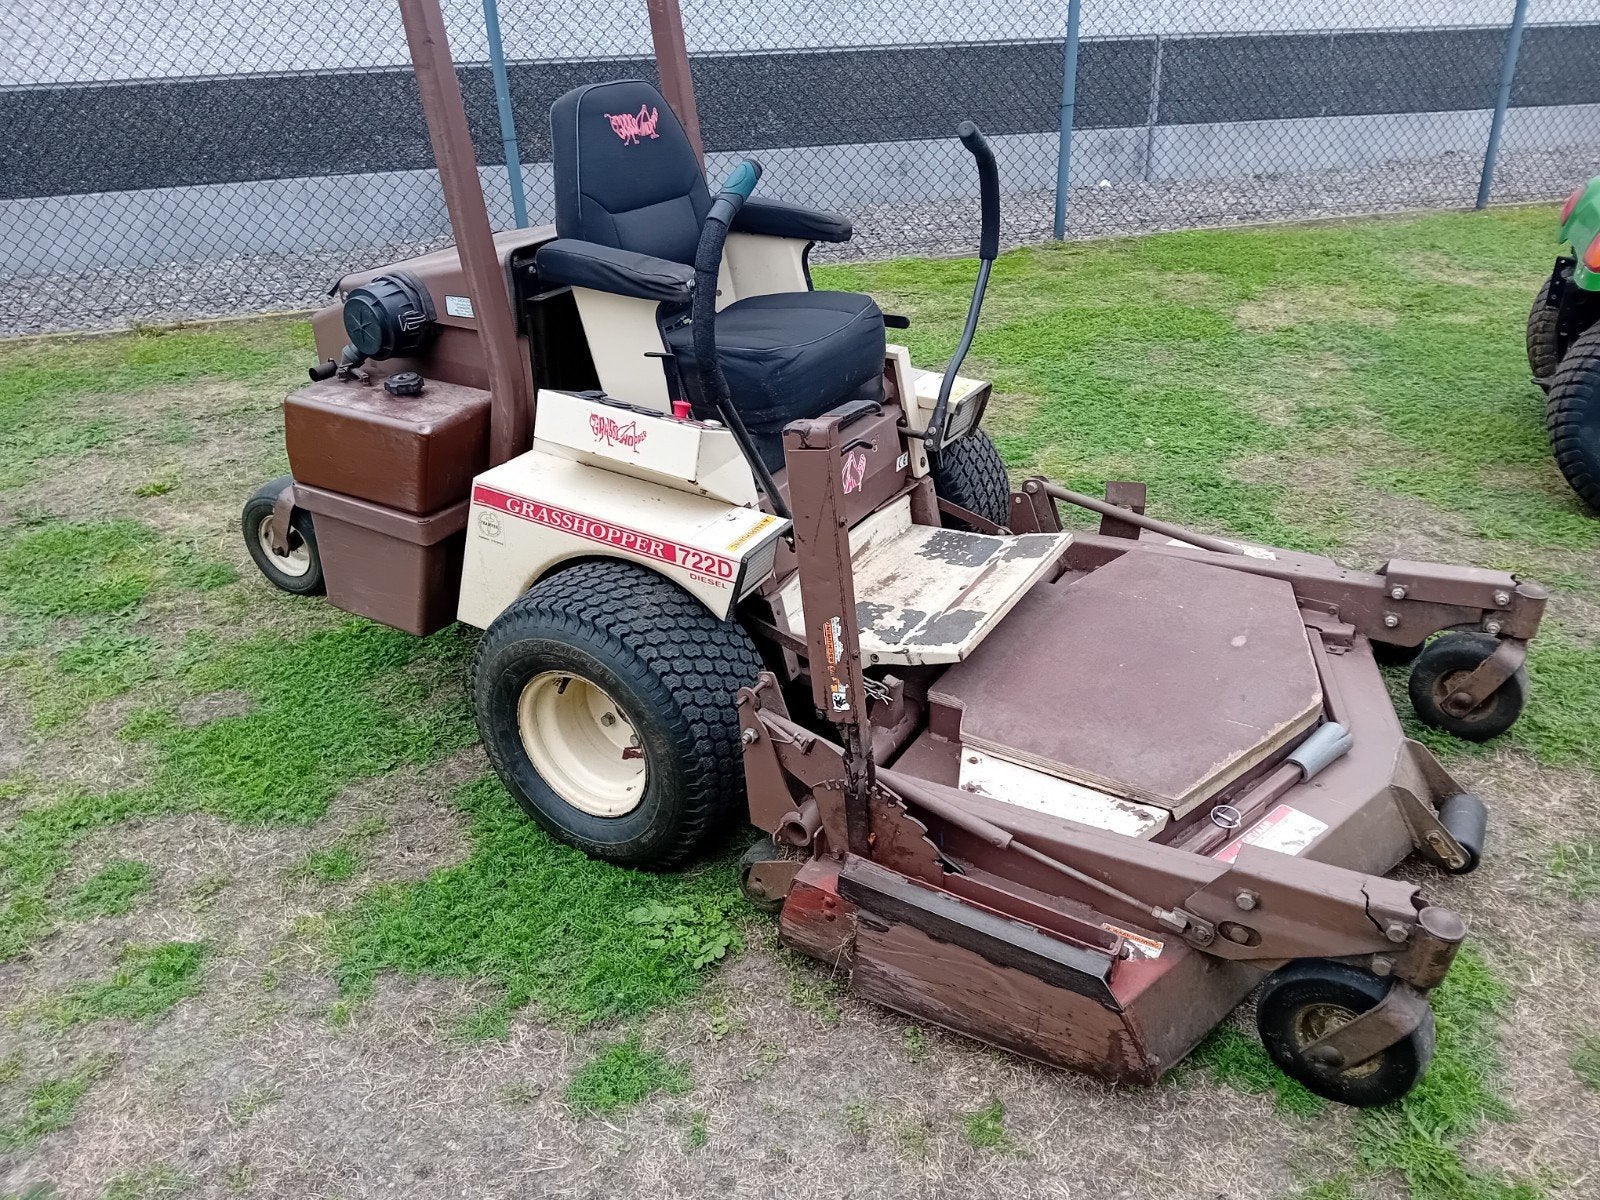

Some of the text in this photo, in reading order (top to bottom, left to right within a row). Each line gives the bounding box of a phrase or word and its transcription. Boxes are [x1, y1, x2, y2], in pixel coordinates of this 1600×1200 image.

[505, 497, 733, 578] GRASSHOPPER 722D
[689, 572, 728, 590] DIESEL
